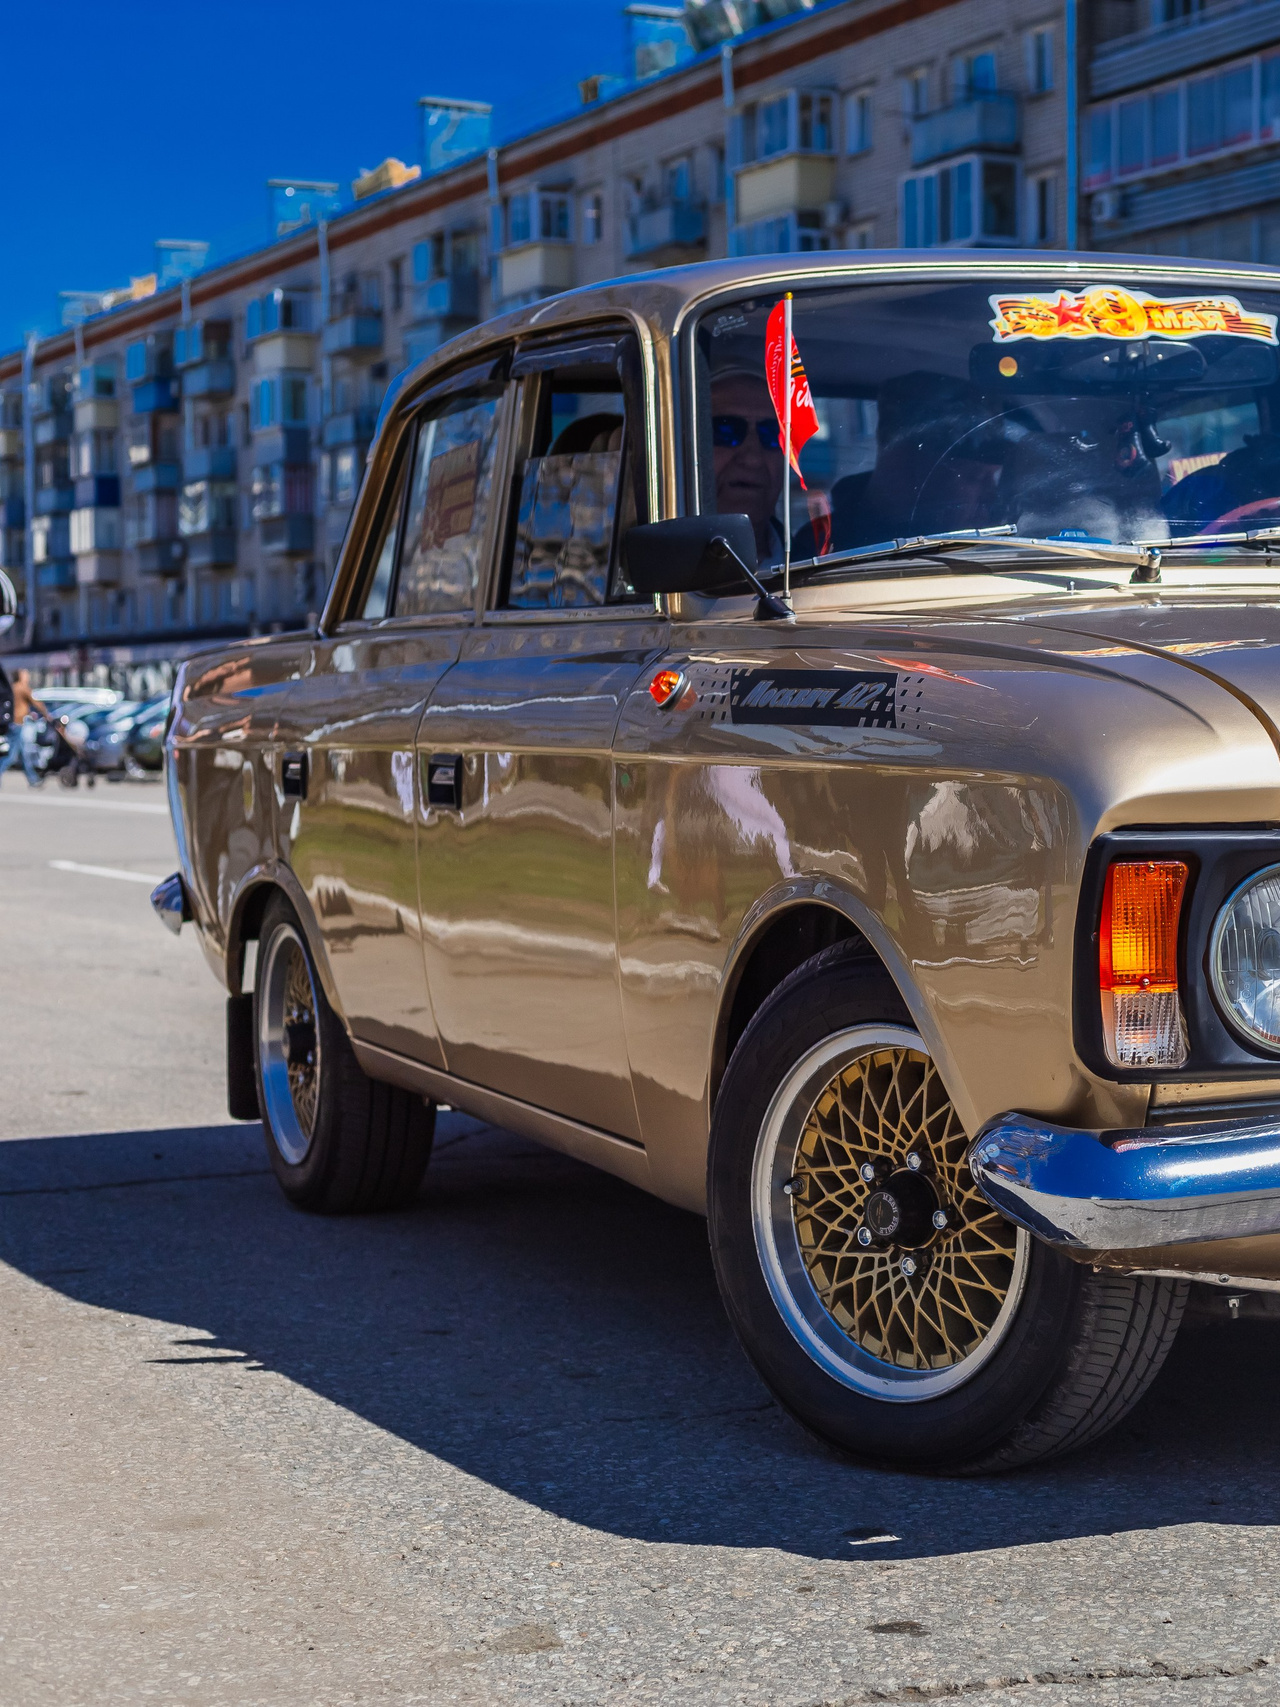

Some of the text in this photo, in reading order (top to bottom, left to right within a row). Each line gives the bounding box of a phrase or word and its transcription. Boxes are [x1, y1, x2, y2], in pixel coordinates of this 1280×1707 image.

[1090, 289, 1226, 337] 9 МАЯ
[833, 682, 888, 710] 412
